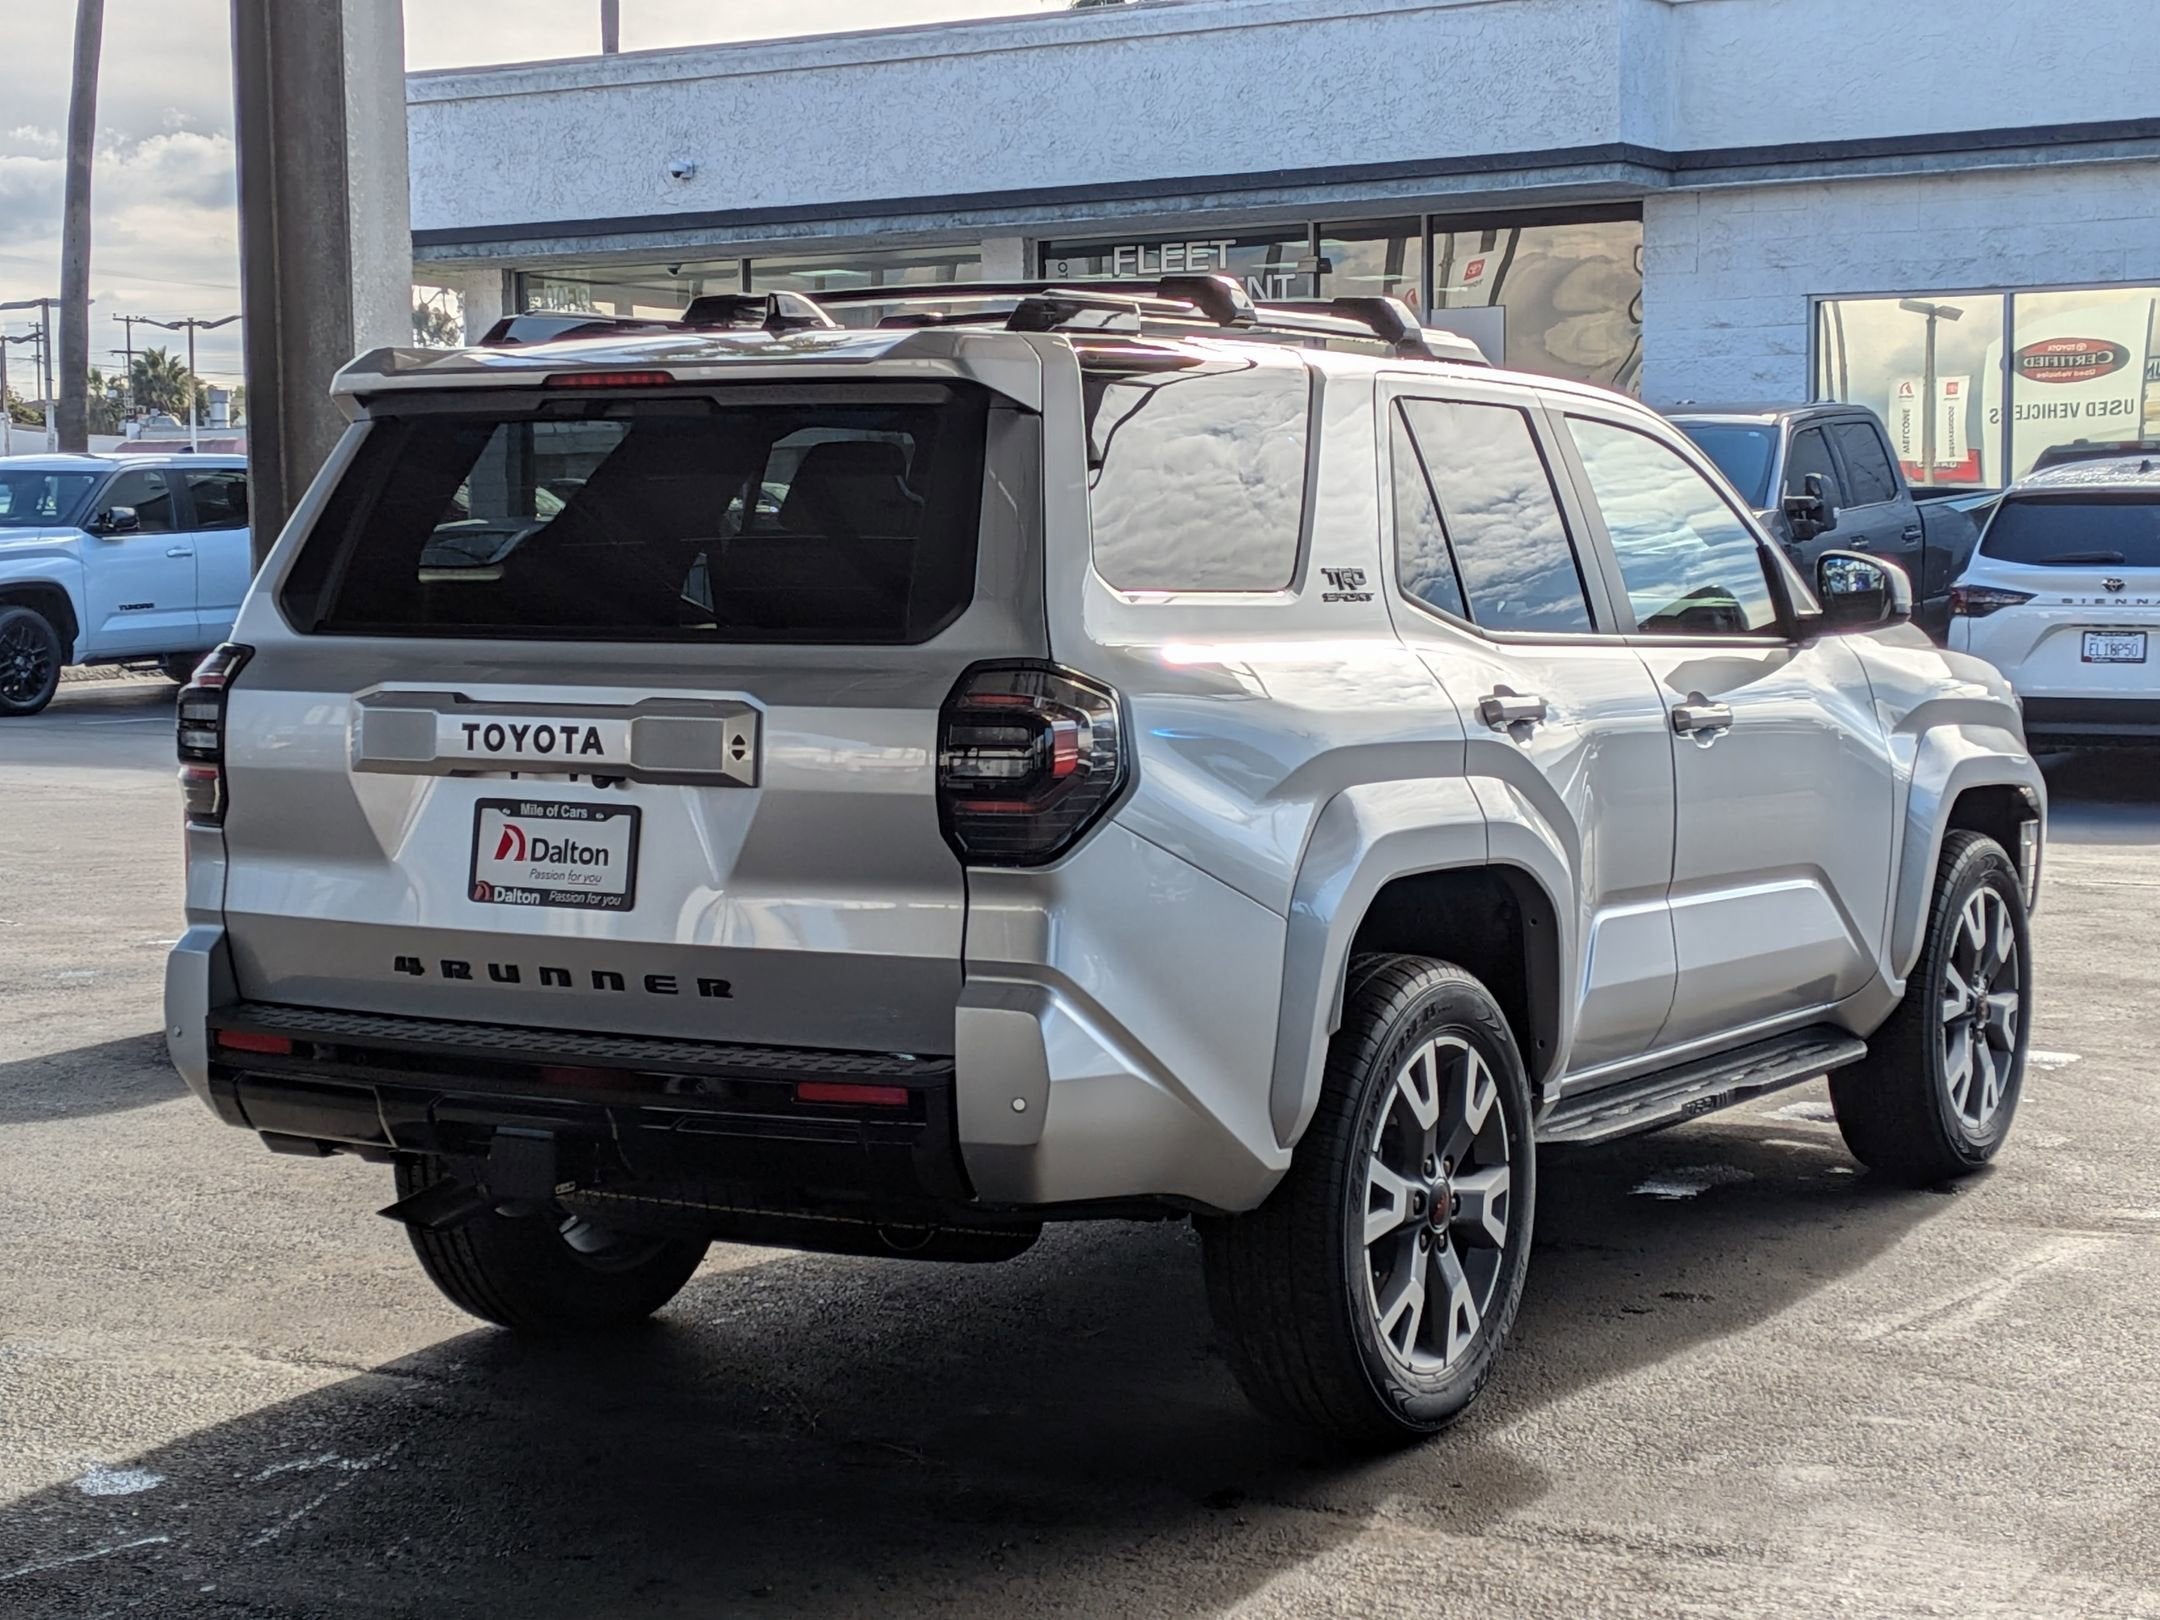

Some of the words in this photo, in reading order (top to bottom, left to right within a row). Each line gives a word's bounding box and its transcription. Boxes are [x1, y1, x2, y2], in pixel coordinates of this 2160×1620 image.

[1113, 239, 1237, 276] FLEET
[1320, 567, 1367, 590] TRD
[461, 722, 605, 756] TOYOTA
[520, 803, 544, 817] Mile
[546, 804, 560, 817] of
[561, 805, 588, 819] Cars
[530, 837, 609, 866] Dalton
[529, 868, 565, 881] Passion
[567, 869, 582, 883] for
[583, 873, 602, 884] you
[494, 886, 540, 904] Dalton
[550, 890, 586, 903] Passion
[586, 892, 602, 905] for
[602, 896, 622, 906] you
[393, 955, 734, 999] 4RUNNER
